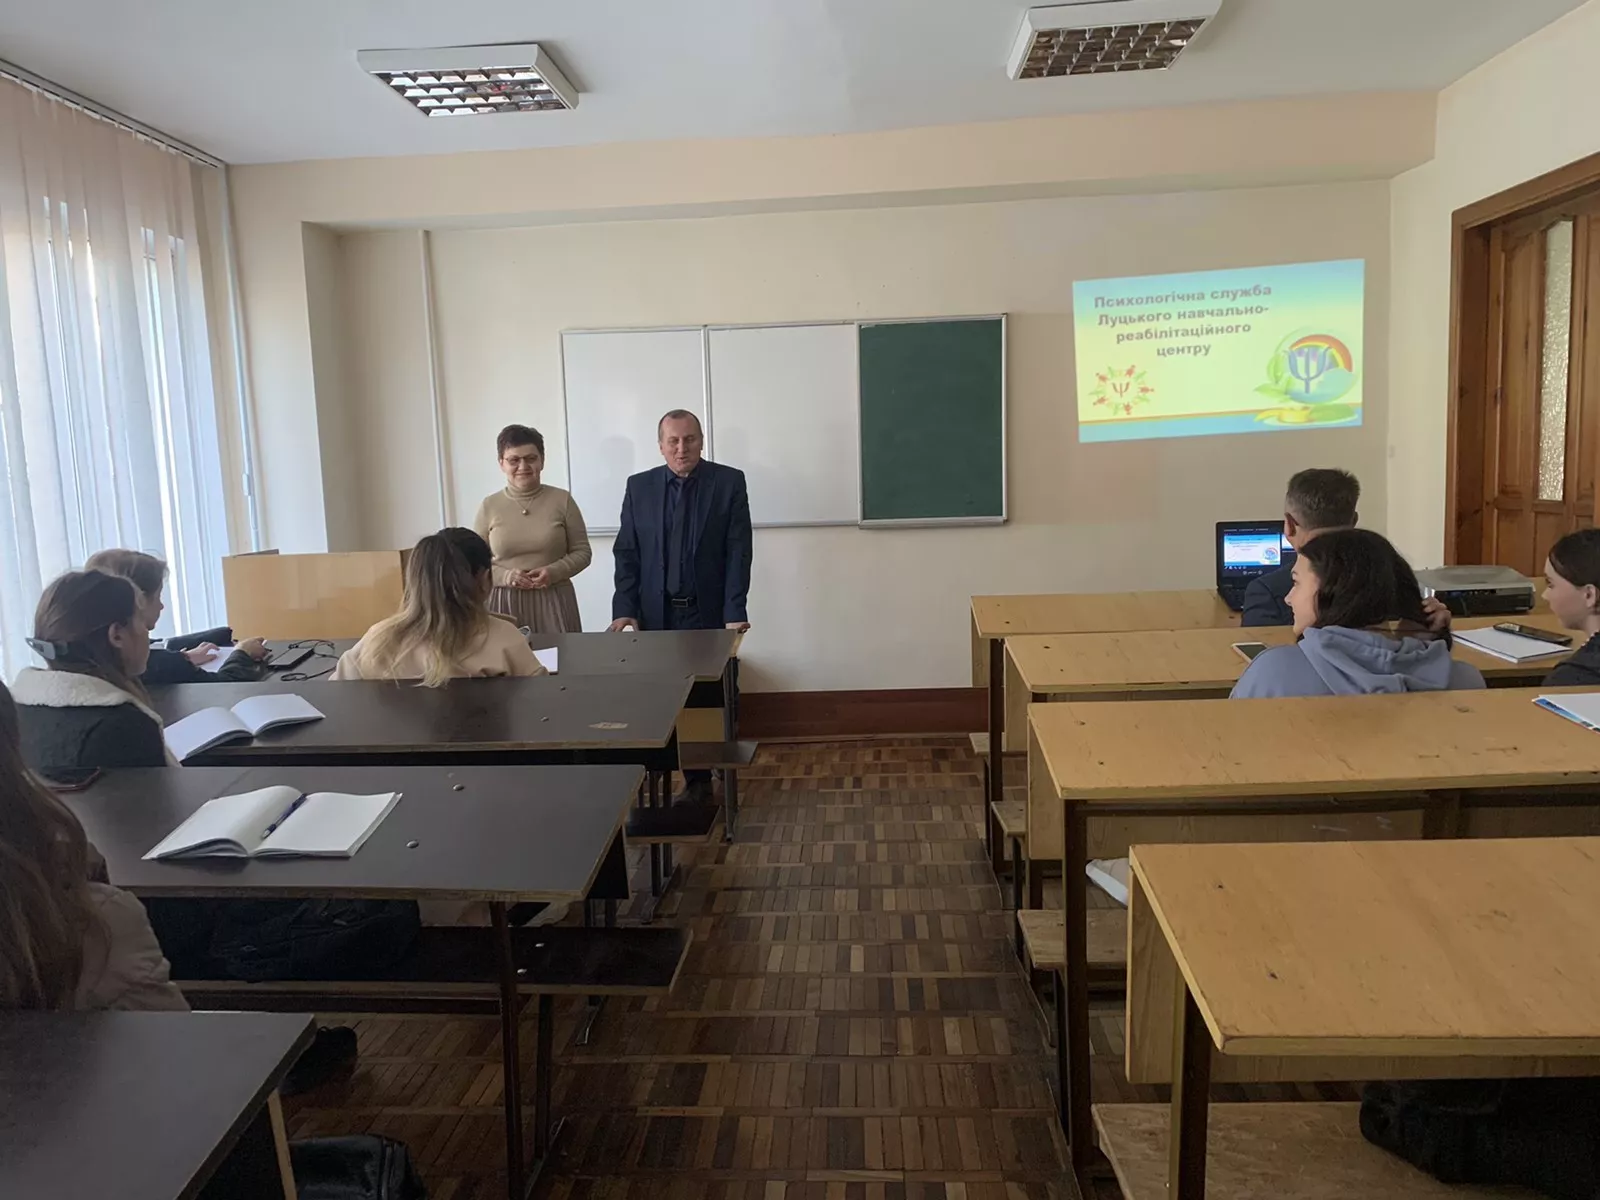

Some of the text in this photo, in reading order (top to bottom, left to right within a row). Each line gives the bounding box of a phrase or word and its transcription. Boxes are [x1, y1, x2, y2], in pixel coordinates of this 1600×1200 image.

[1094, 284, 1271, 308] Психологічна служба
[1098, 305, 1269, 328] Луцького навчально-
[1116, 323, 1251, 344] реабілітаційного
[1156, 344, 1211, 357] центру
